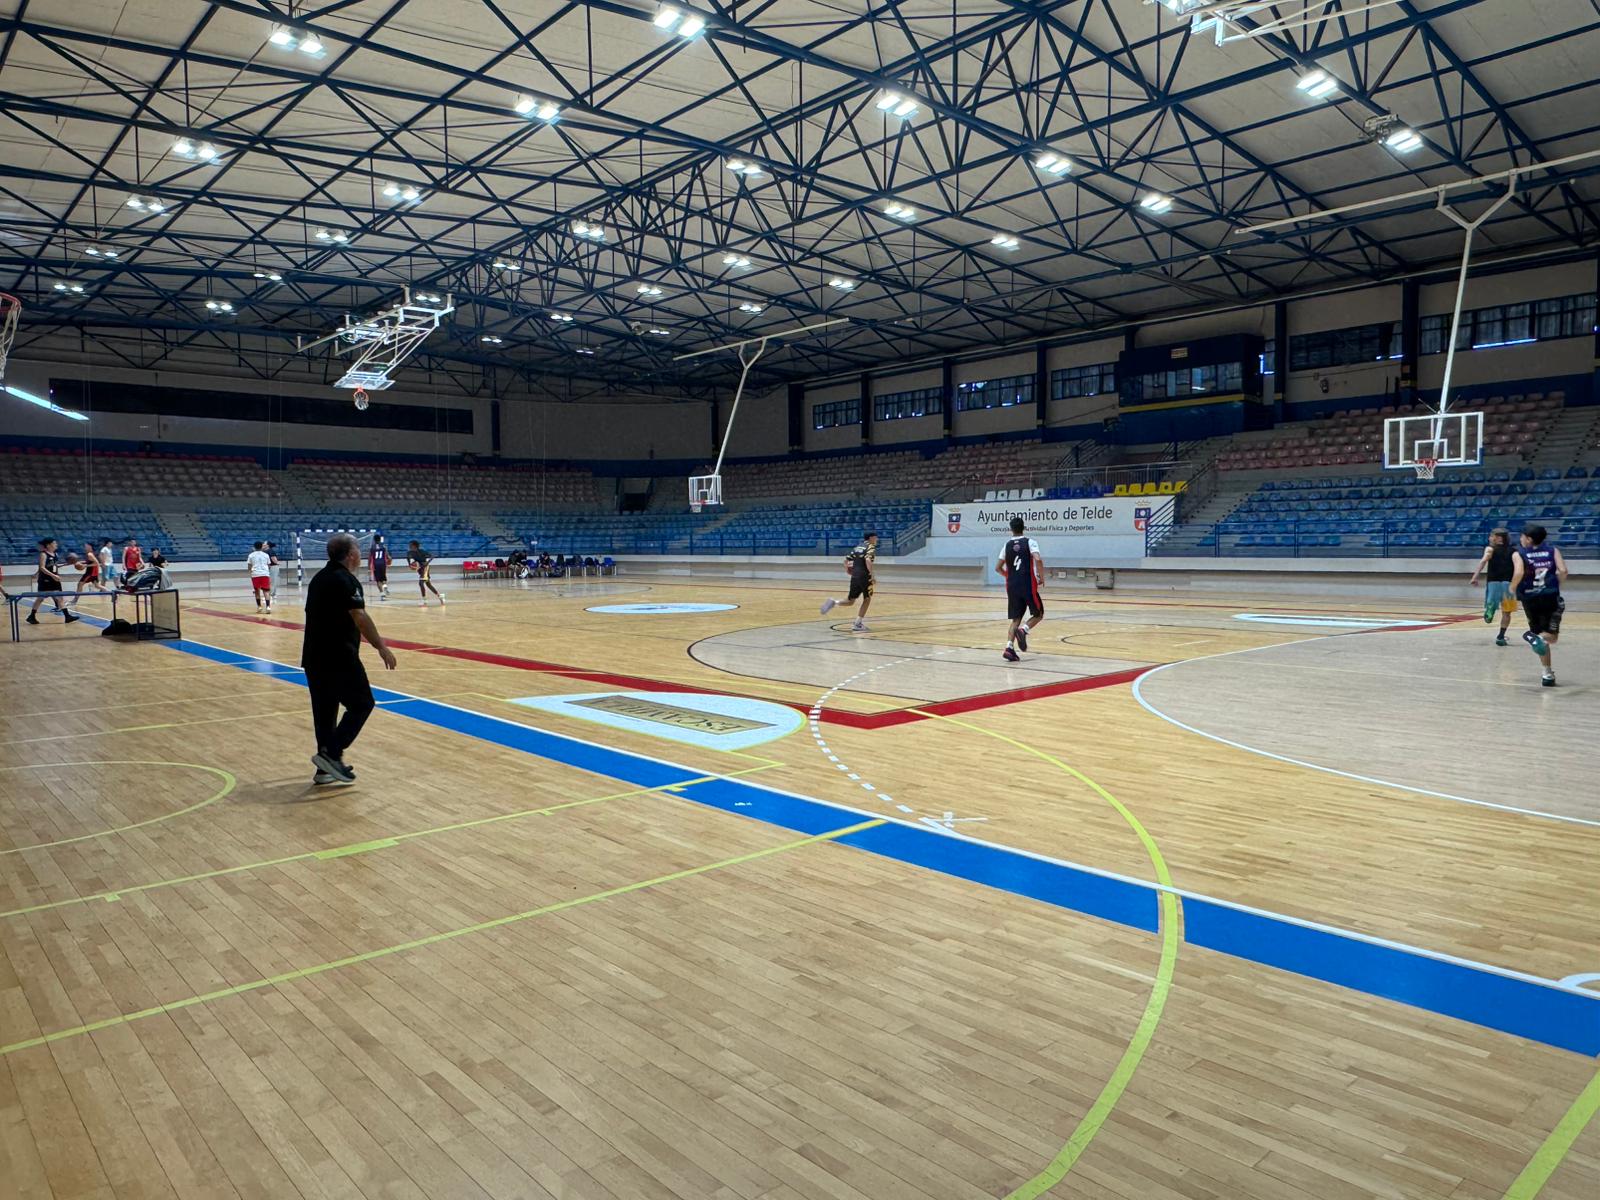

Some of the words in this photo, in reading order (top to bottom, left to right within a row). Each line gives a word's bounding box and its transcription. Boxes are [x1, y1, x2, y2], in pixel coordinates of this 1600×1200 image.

[977, 508, 1058, 524] Ayuntamiento
[1063, 507, 1077, 519] de
[1081, 506, 1113, 519] Telde
[1069, 524, 1095, 533] Deportes
[375, 551, 383, 559] 11
[1013, 555, 1022, 571] 4
